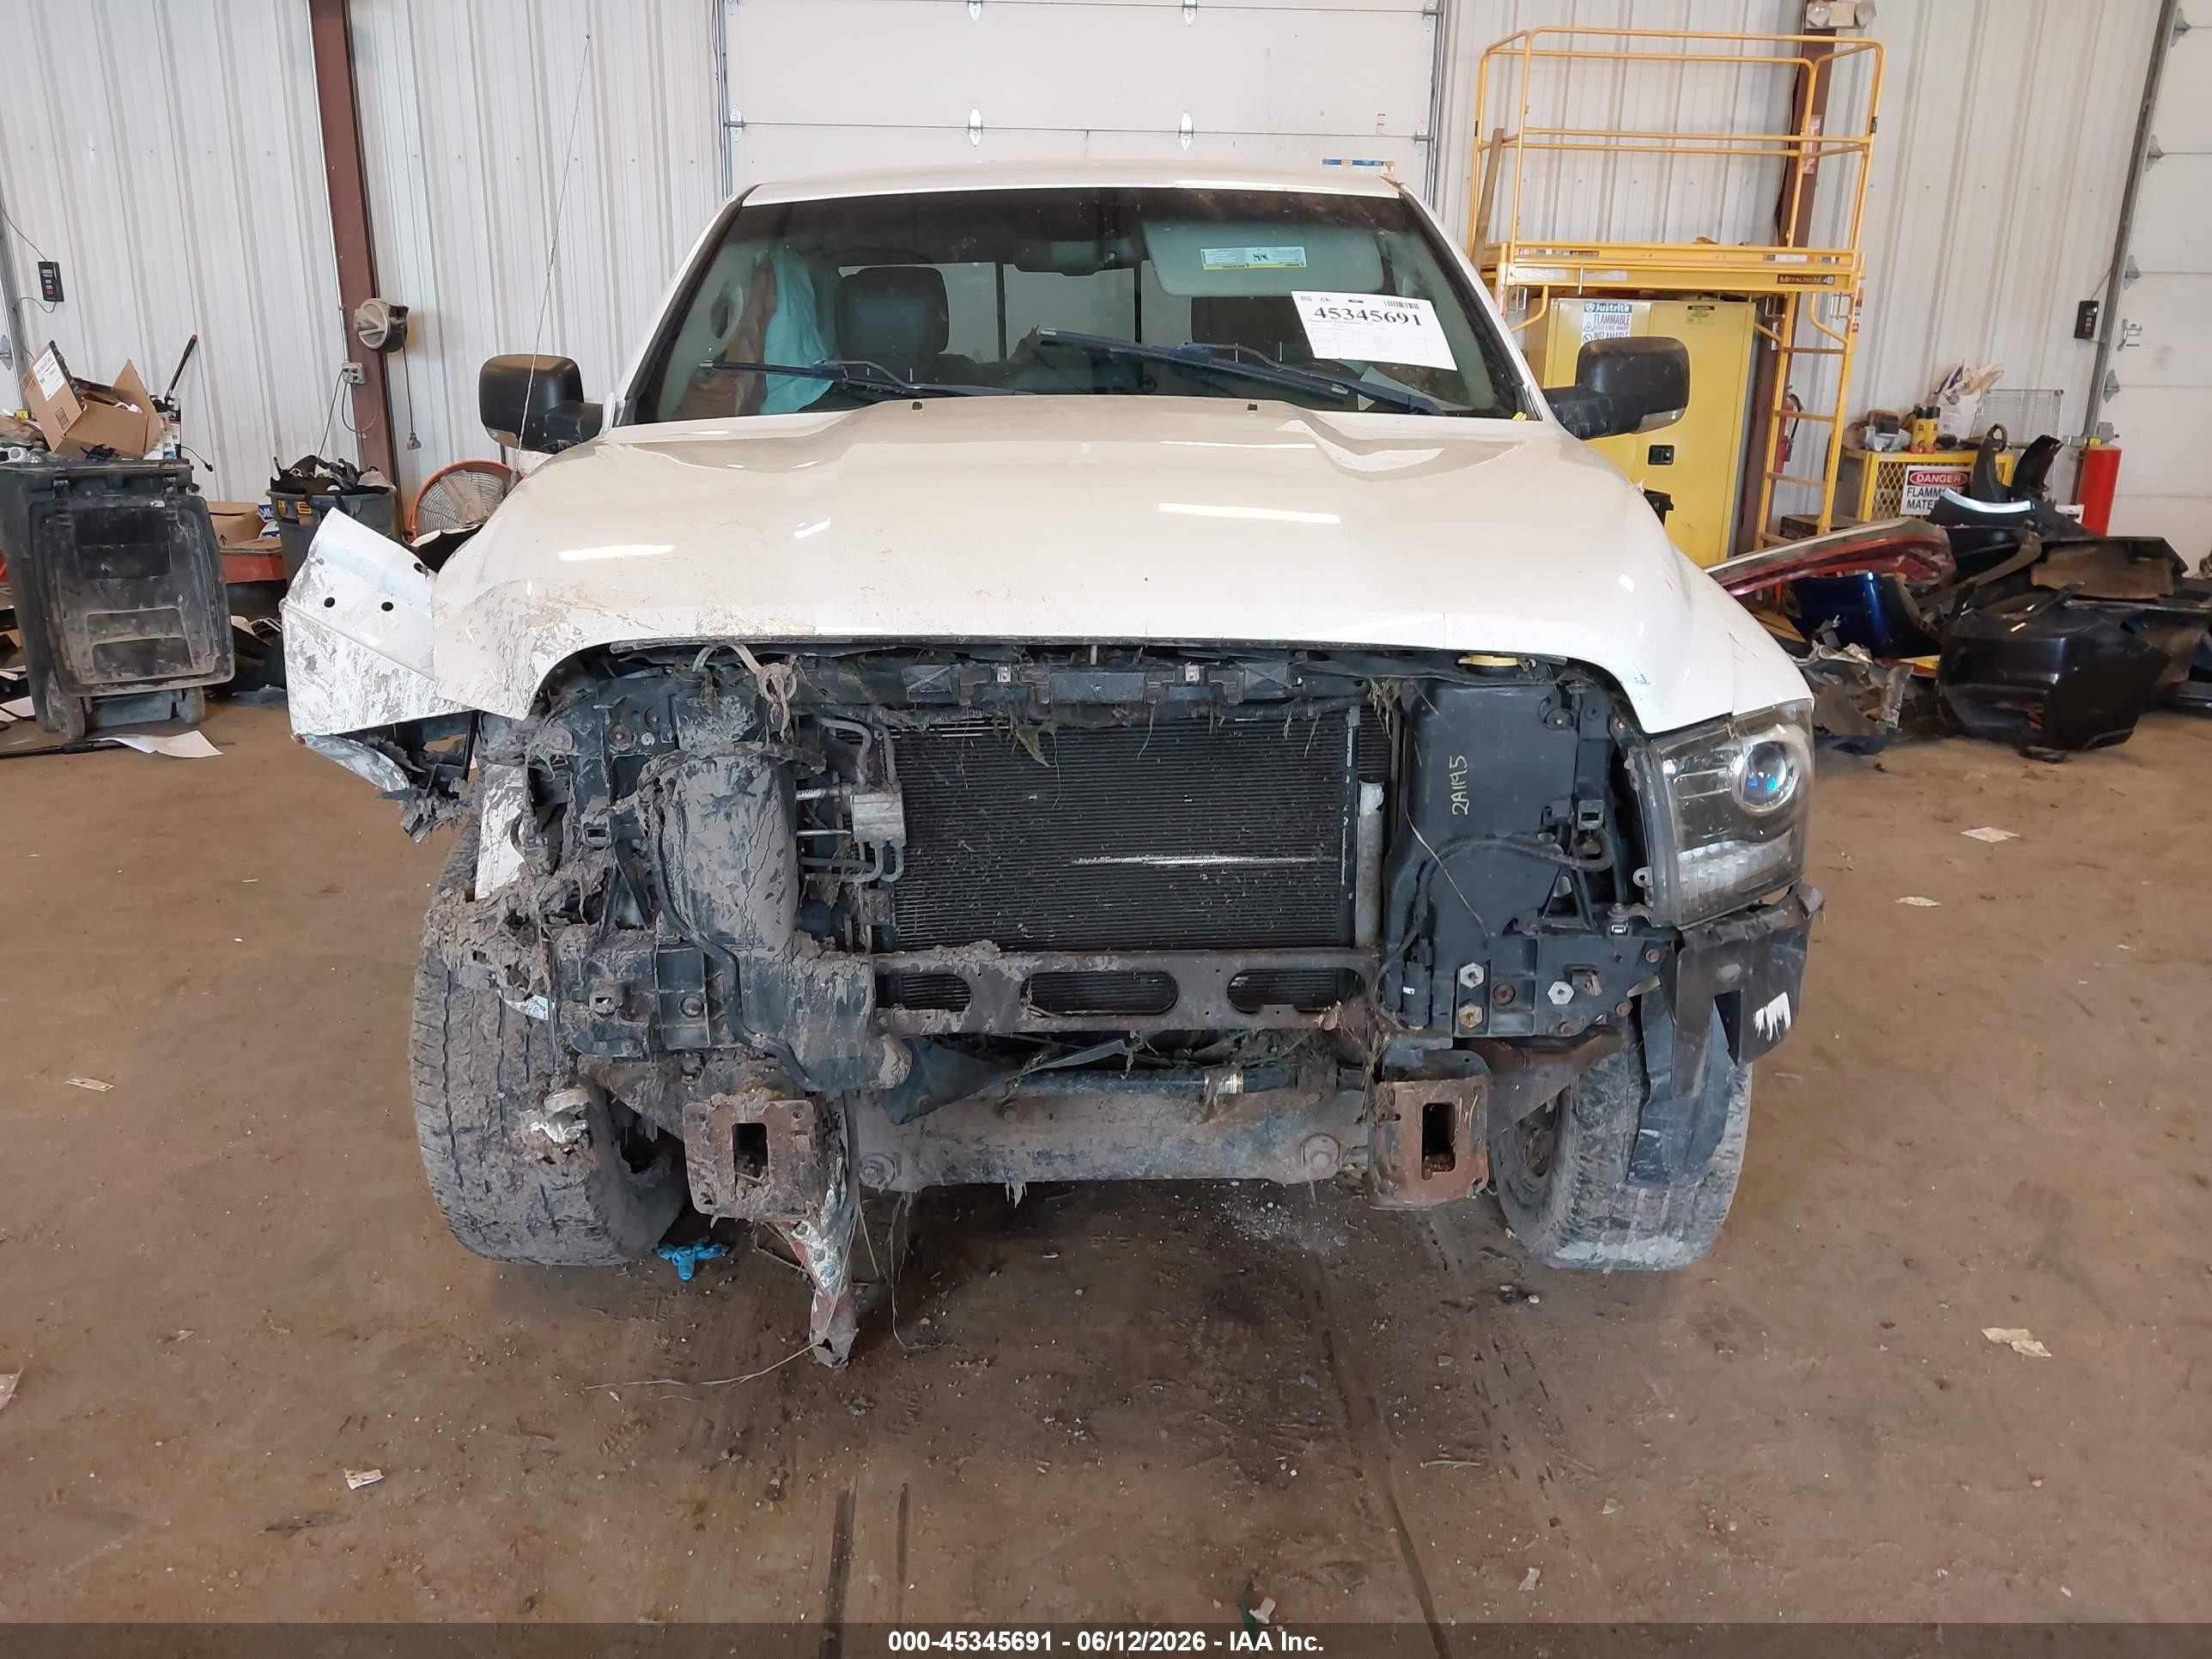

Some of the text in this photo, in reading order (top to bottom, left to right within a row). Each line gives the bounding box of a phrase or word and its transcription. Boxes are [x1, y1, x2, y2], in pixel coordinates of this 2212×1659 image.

[1314, 307, 1422, 326] 45345691
[1594, 313, 1630, 325] FLAMMABLE
[1916, 474, 1961, 483] DANGER
[1906, 487, 1942, 497] FLAMM
[1906, 499, 1938, 510] MATE
